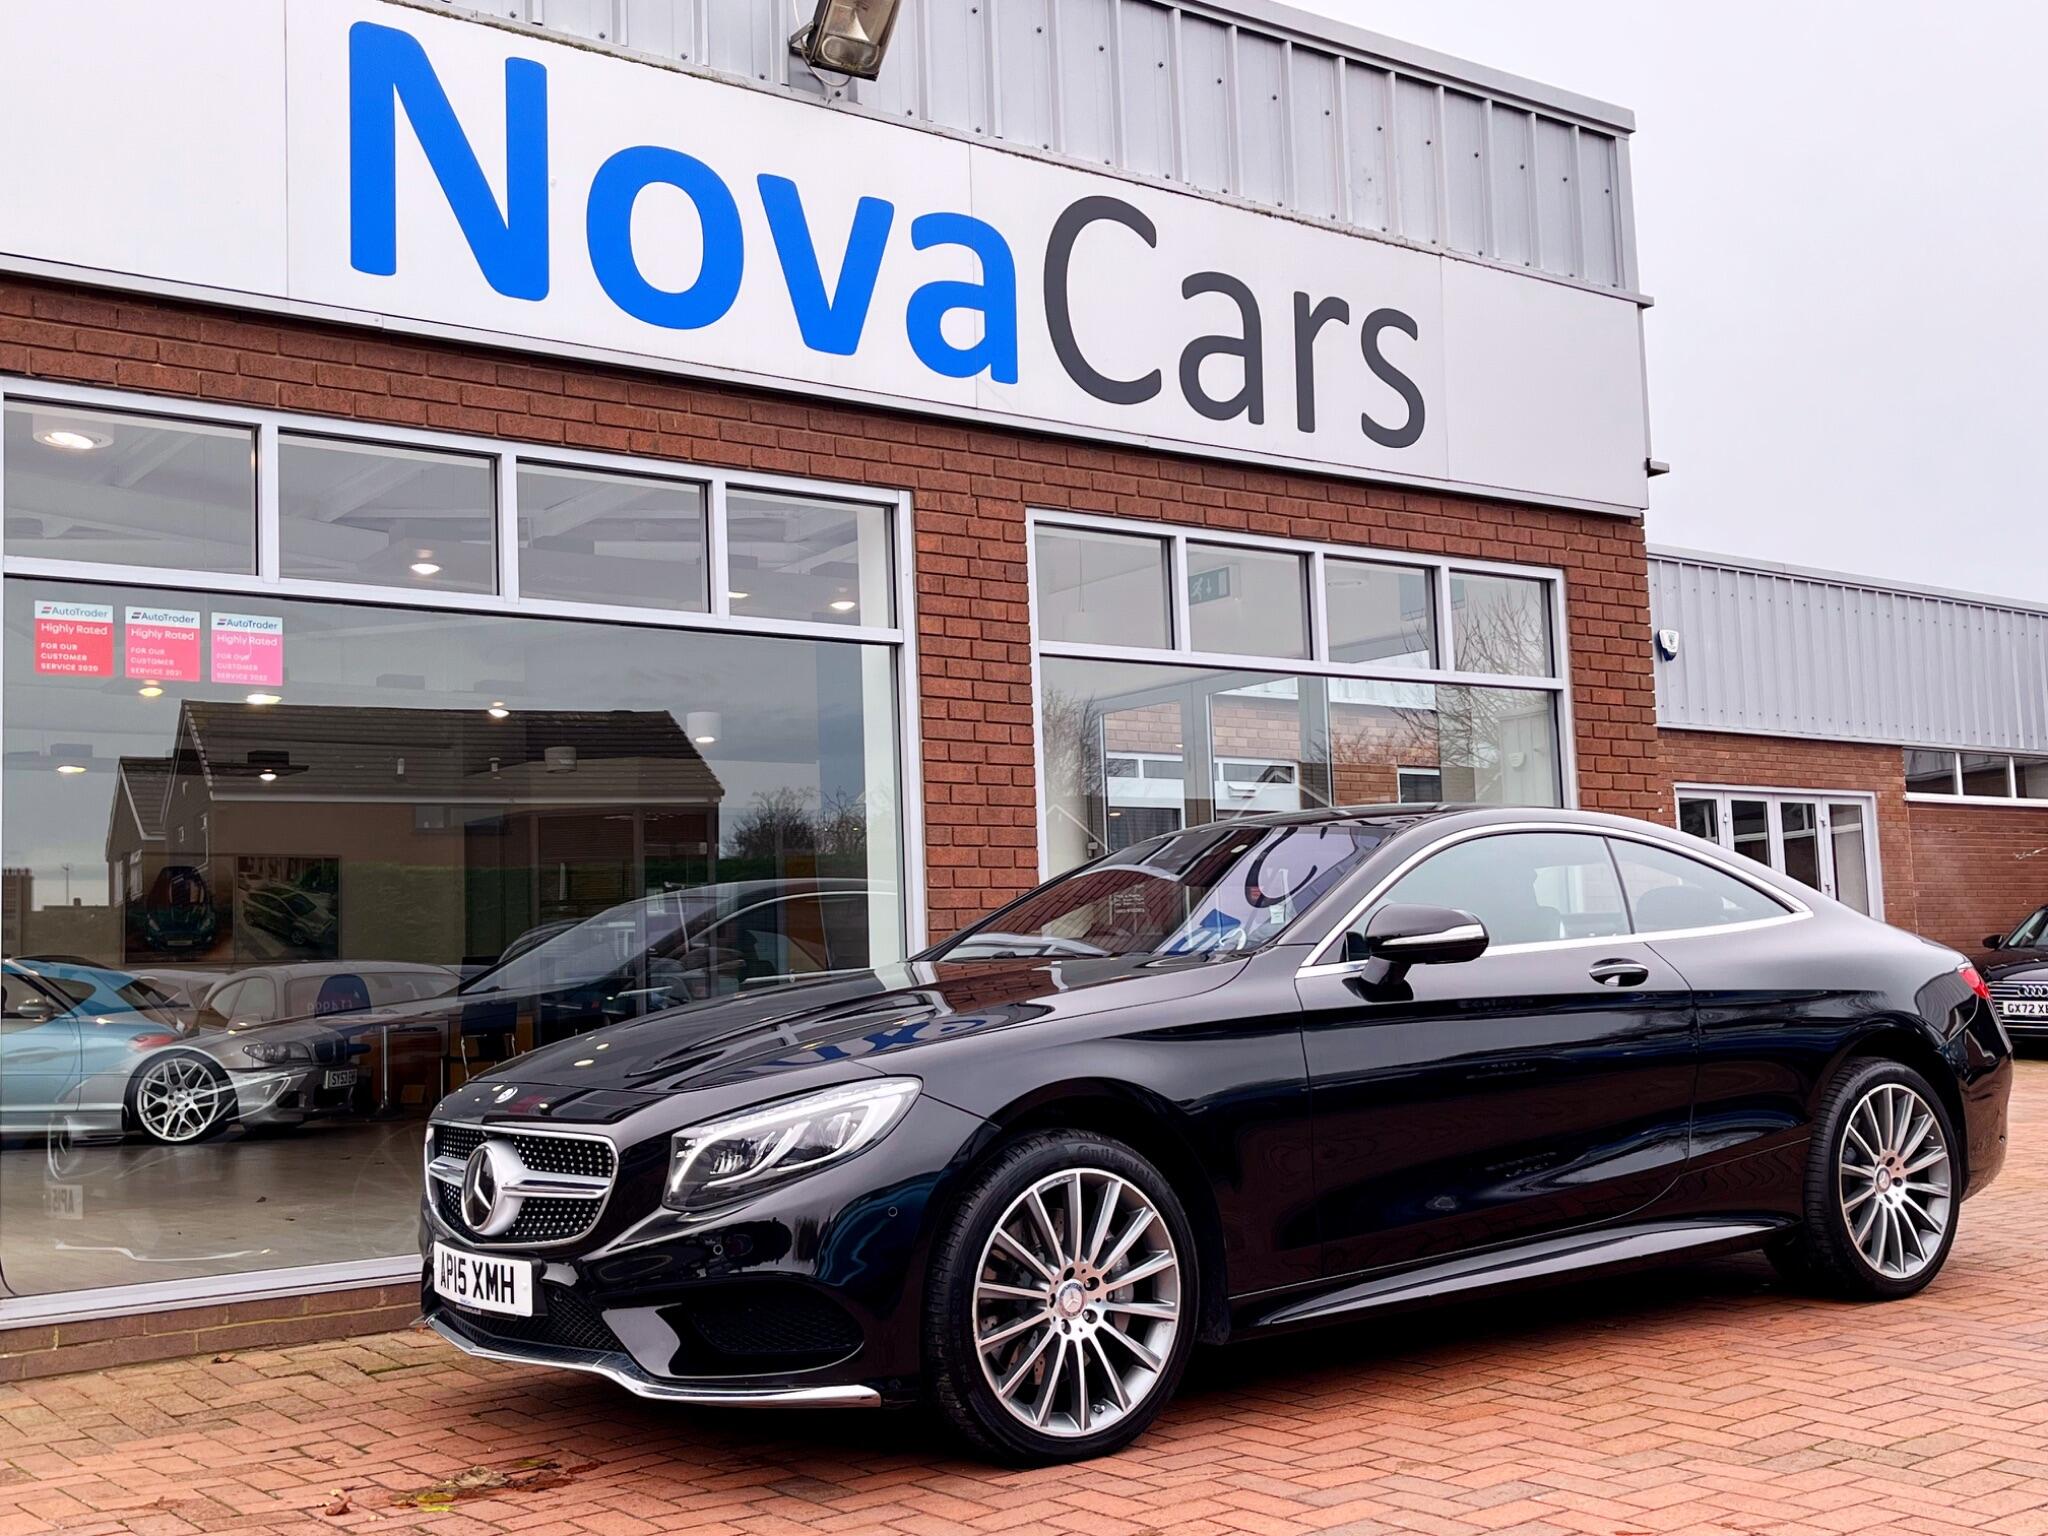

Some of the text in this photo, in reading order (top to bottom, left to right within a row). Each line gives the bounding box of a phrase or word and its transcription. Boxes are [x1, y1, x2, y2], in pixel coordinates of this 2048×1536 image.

[350, 21, 1426, 448] NovaCars
[52, 606, 108, 618] AutoTrader
[141, 612, 195, 624] AutoTrader
[41, 623, 108, 636] Highly Rated
[226, 619, 277, 630] AutoTrader
[131, 628, 195, 641] Highly Rated
[216, 634, 278, 647] Highly Rated
[41, 642, 78, 651] FOR OUR
[130, 647, 165, 656] FOR OUR
[41, 652, 88, 662] CUSTOMER
[130, 657, 175, 666] CUSTOMER
[41, 663, 76, 672] SERVICE
[130, 667, 183, 677] SERVICE 2021
[216, 662, 258, 671] CUSTOMER
[216, 672, 248, 680] SERVICE
[2007, 1003, 2036, 1014] GX72
[441, 1251, 515, 1305] AP15 XMH
